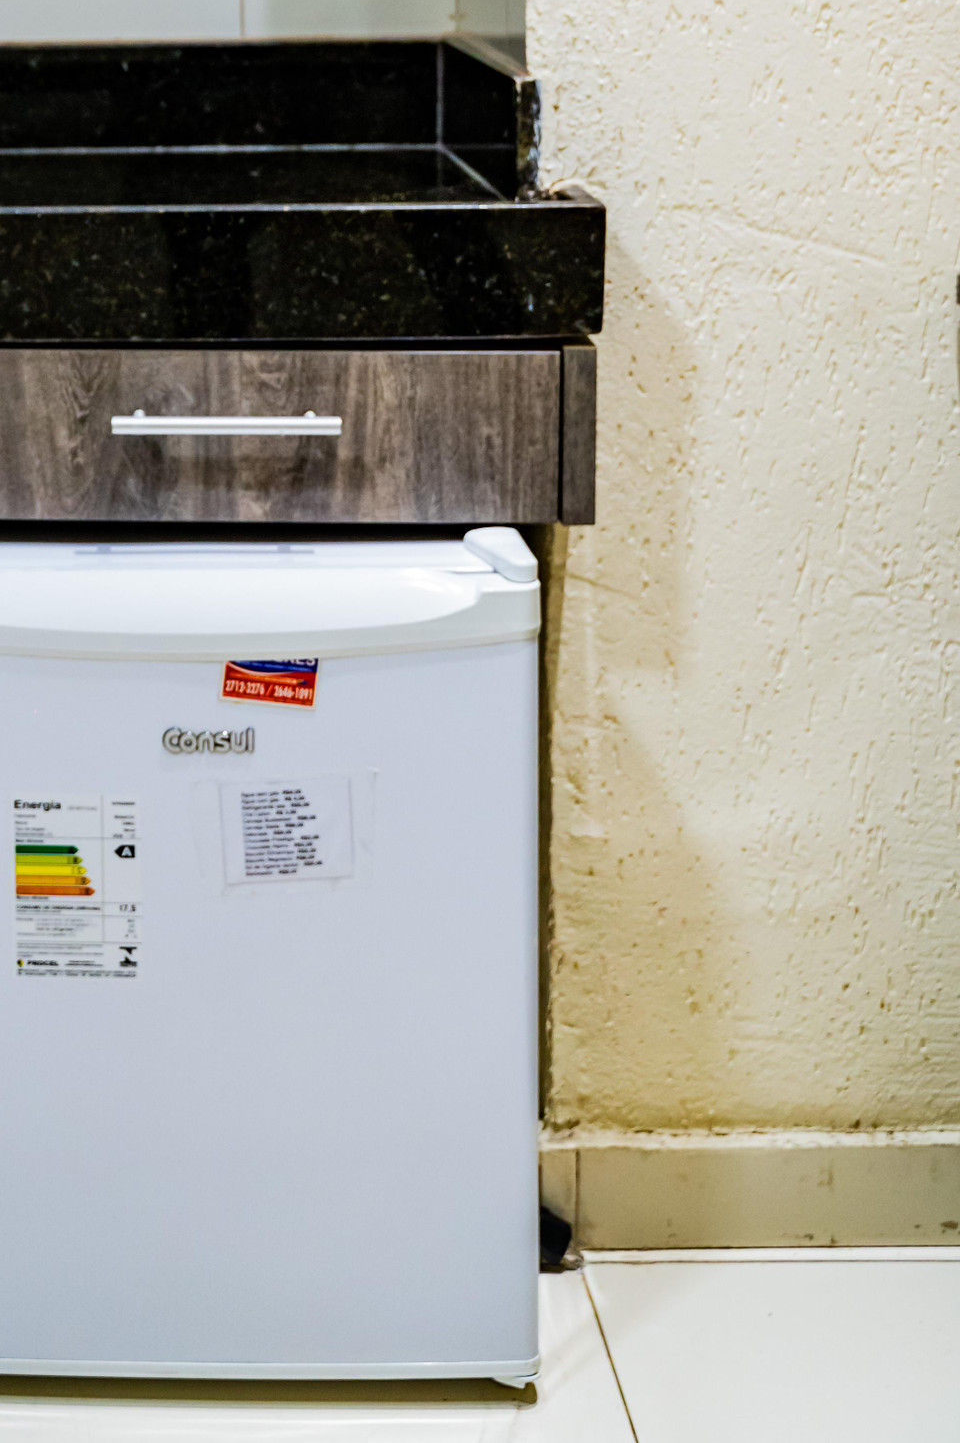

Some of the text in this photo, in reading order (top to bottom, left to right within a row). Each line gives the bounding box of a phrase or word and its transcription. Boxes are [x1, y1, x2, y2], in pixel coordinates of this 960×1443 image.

[162, 726, 255, 754] Consul
[14, 799, 62, 812] Energia
[121, 846, 133, 857] A
